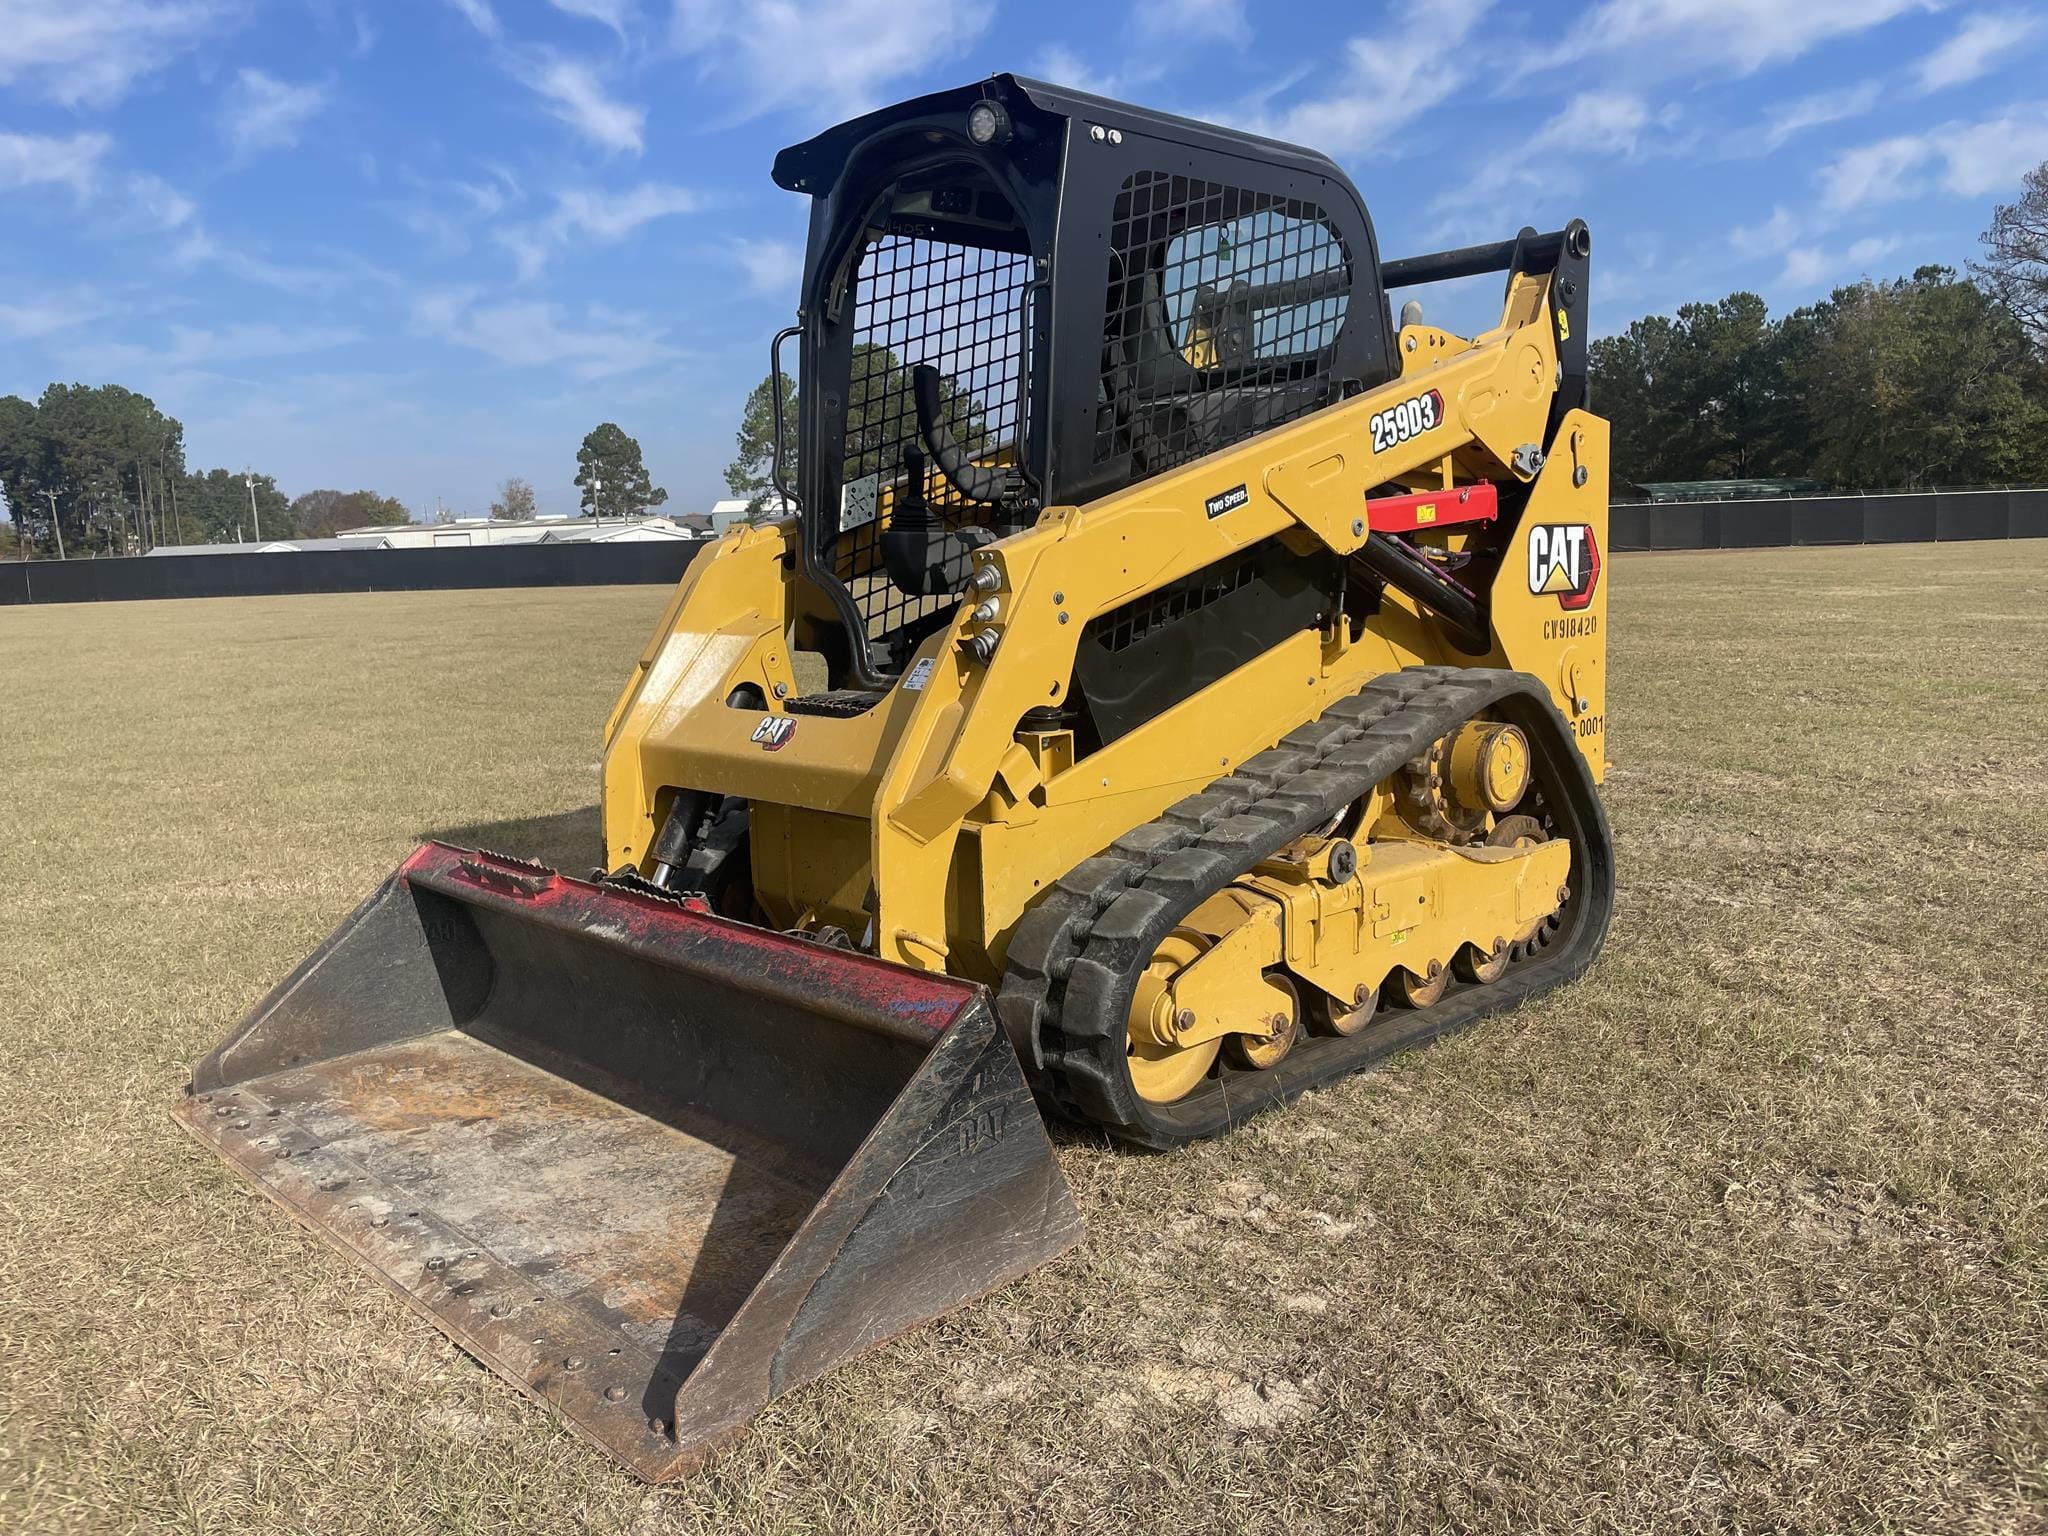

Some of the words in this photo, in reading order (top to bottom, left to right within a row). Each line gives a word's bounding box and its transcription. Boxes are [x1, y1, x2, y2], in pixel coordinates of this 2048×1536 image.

[1370, 394, 1435, 453] 259D3
[1529, 526, 1584, 593] CAT
[751, 716, 793, 743] CAT
[1580, 715, 1603, 737] 0001
[959, 1106, 1005, 1158] CAT
